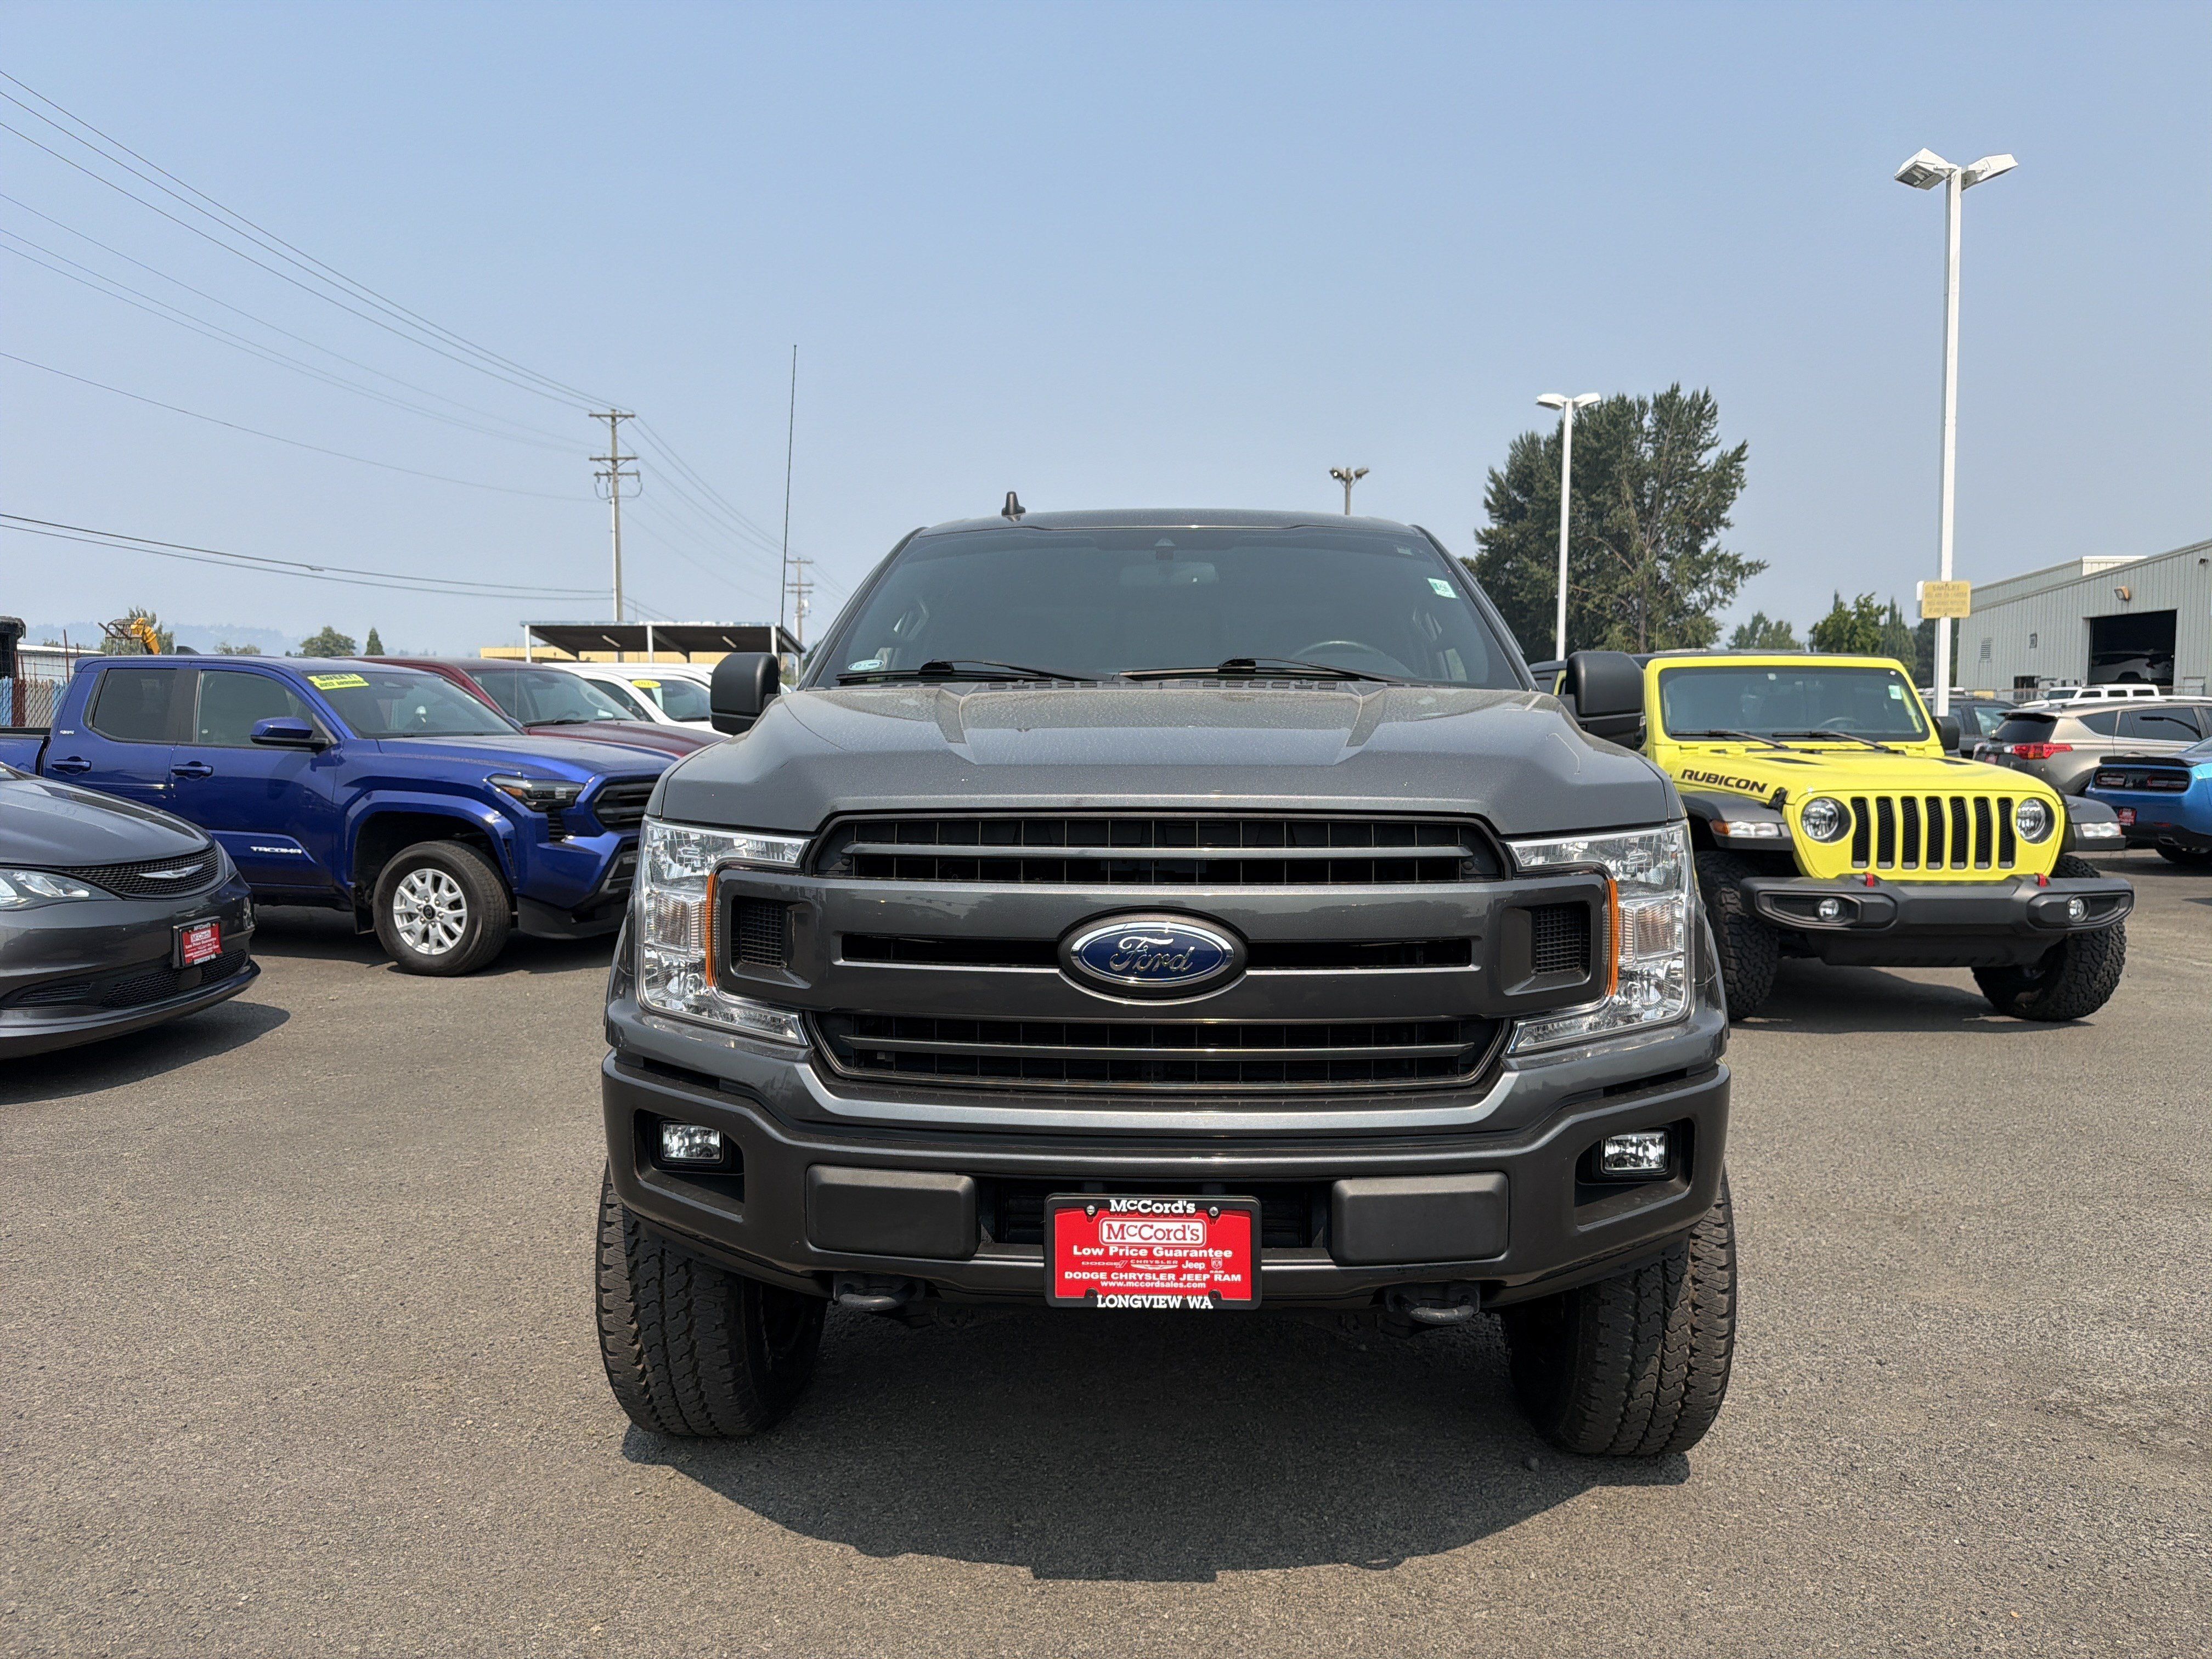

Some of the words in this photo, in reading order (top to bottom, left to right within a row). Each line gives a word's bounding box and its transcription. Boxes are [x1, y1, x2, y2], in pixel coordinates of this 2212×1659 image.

[1680, 769, 1768, 794] RUBICON
[1109, 936, 1195, 972] Ford
[1109, 1199, 1196, 1214] McCord's
[1105, 1223, 1200, 1242] McCord's
[1073, 1245, 1104, 1256] Low
[1109, 1246, 1148, 1257] Price
[1153, 1247, 1233, 1258] Guarantee
[1181, 1260, 1205, 1270] Jeep
[1064, 1272, 1107, 1280] DODGE
[1111, 1272, 1176, 1281] CHRYSLER
[1097, 1295, 1182, 1308] LONGVIEW
[1187, 1296, 1213, 1309] WA
